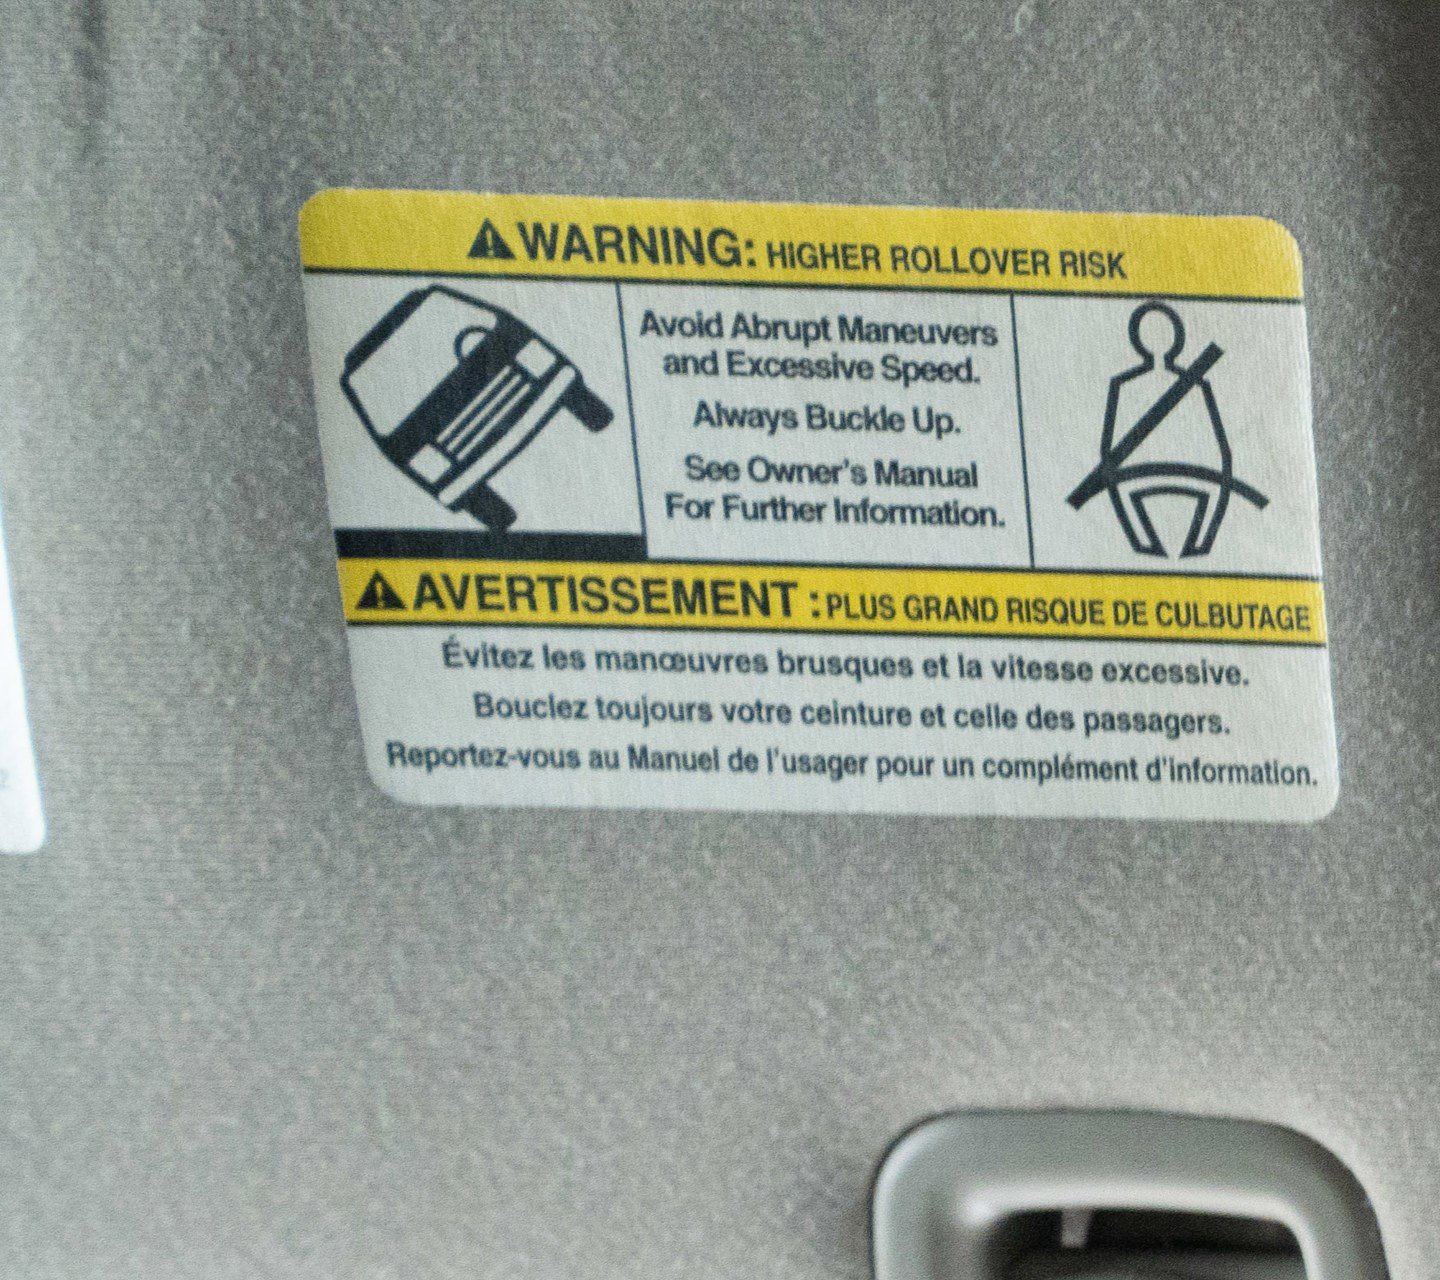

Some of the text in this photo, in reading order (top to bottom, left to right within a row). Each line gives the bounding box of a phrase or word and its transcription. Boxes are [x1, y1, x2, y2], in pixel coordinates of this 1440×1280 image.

[516, 221, 1129, 281] WARNING: HIGHER ROLLOVER RISK
[639, 310, 998, 347] Avoid Abrupt Maneuvers
[662, 350, 981, 387] and Excessive Speed.
[693, 400, 962, 440] Always Buckle Up.
[684, 455, 979, 489] See Owner's Manual
[664, 493, 1007, 528] For Further Information.
[902, 595, 1000, 623] GRAND
[1006, 599, 1104, 627] RISQUE
[1112, 601, 1148, 628] DE
[1155, 602, 1312, 632] CULBUTAGE
[543, 644, 586, 671] les
[778, 650, 913, 681] brusques
[922, 655, 950, 679] et
[957, 654, 983, 679] la
[992, 655, 1094, 682] vitesse
[1101, 658, 1249, 686] excessive.
[473, 691, 1230, 739] Bouclez toujours votre ceinture et celle des passagers.
[386, 740, 580, 774] Reportez-vous
[588, 748, 620, 771] au
[627, 744, 720, 773] Manuel
[727, 747, 760, 774] de
[876, 757, 939, 782] pour
[944, 757, 975, 778] un
[982, 753, 1140, 785] complément
